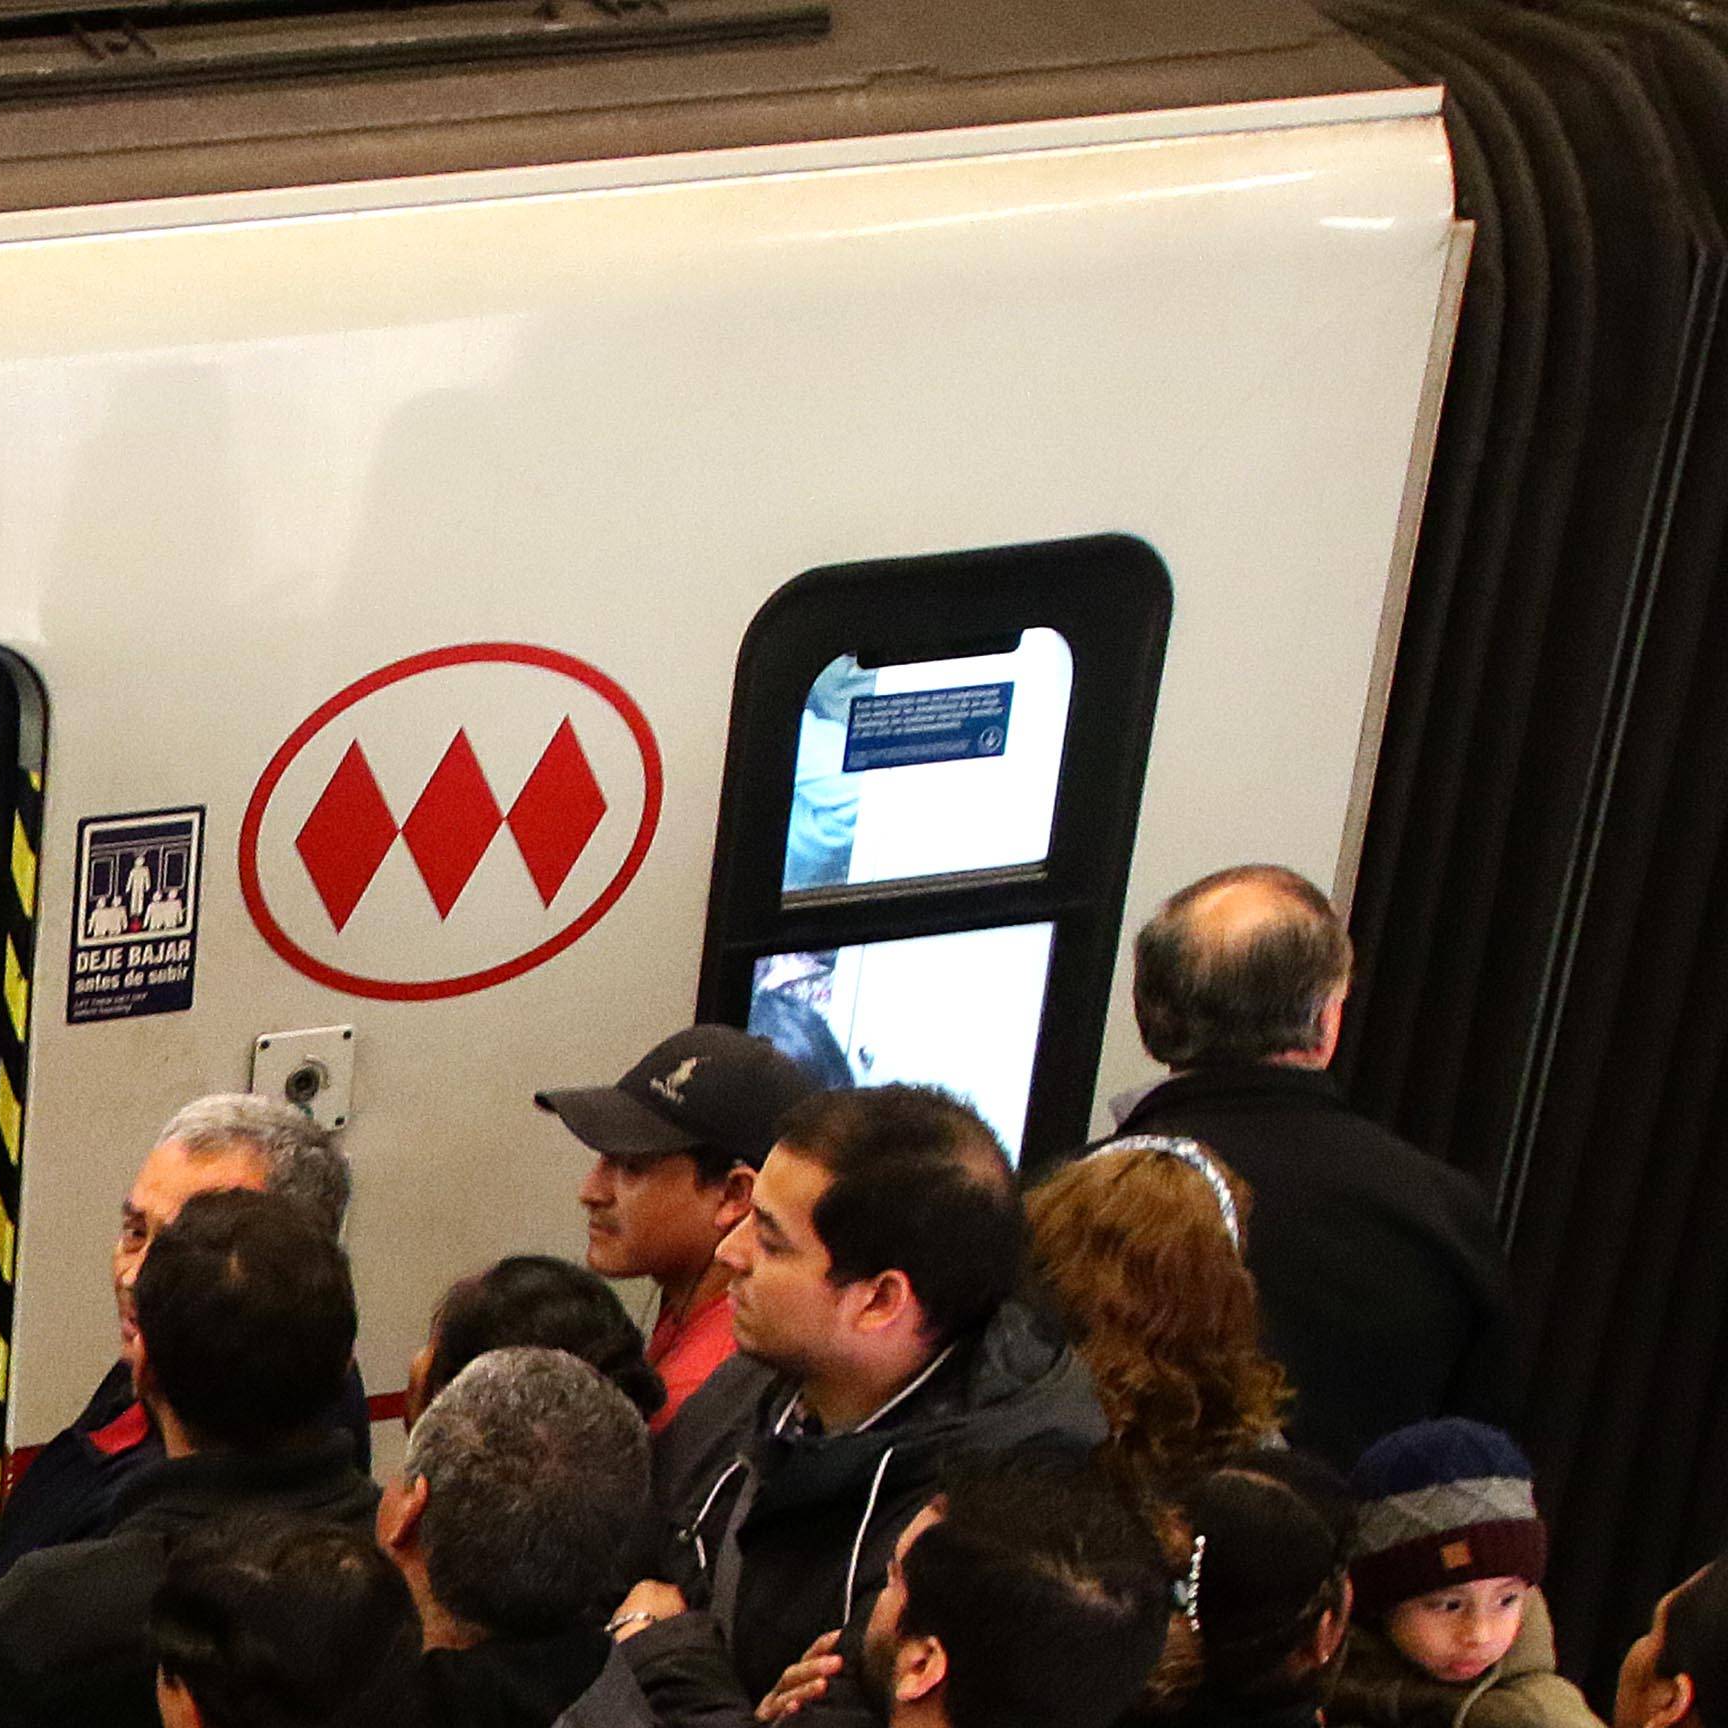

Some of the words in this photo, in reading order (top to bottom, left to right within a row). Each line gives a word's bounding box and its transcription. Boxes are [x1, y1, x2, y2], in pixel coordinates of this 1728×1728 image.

[76, 948, 124, 974] DEJE
[128, 940, 192, 968] BAJAR
[75, 973, 120, 993] antes
[124, 970, 144, 986] de
[148, 963, 189, 984] subir
